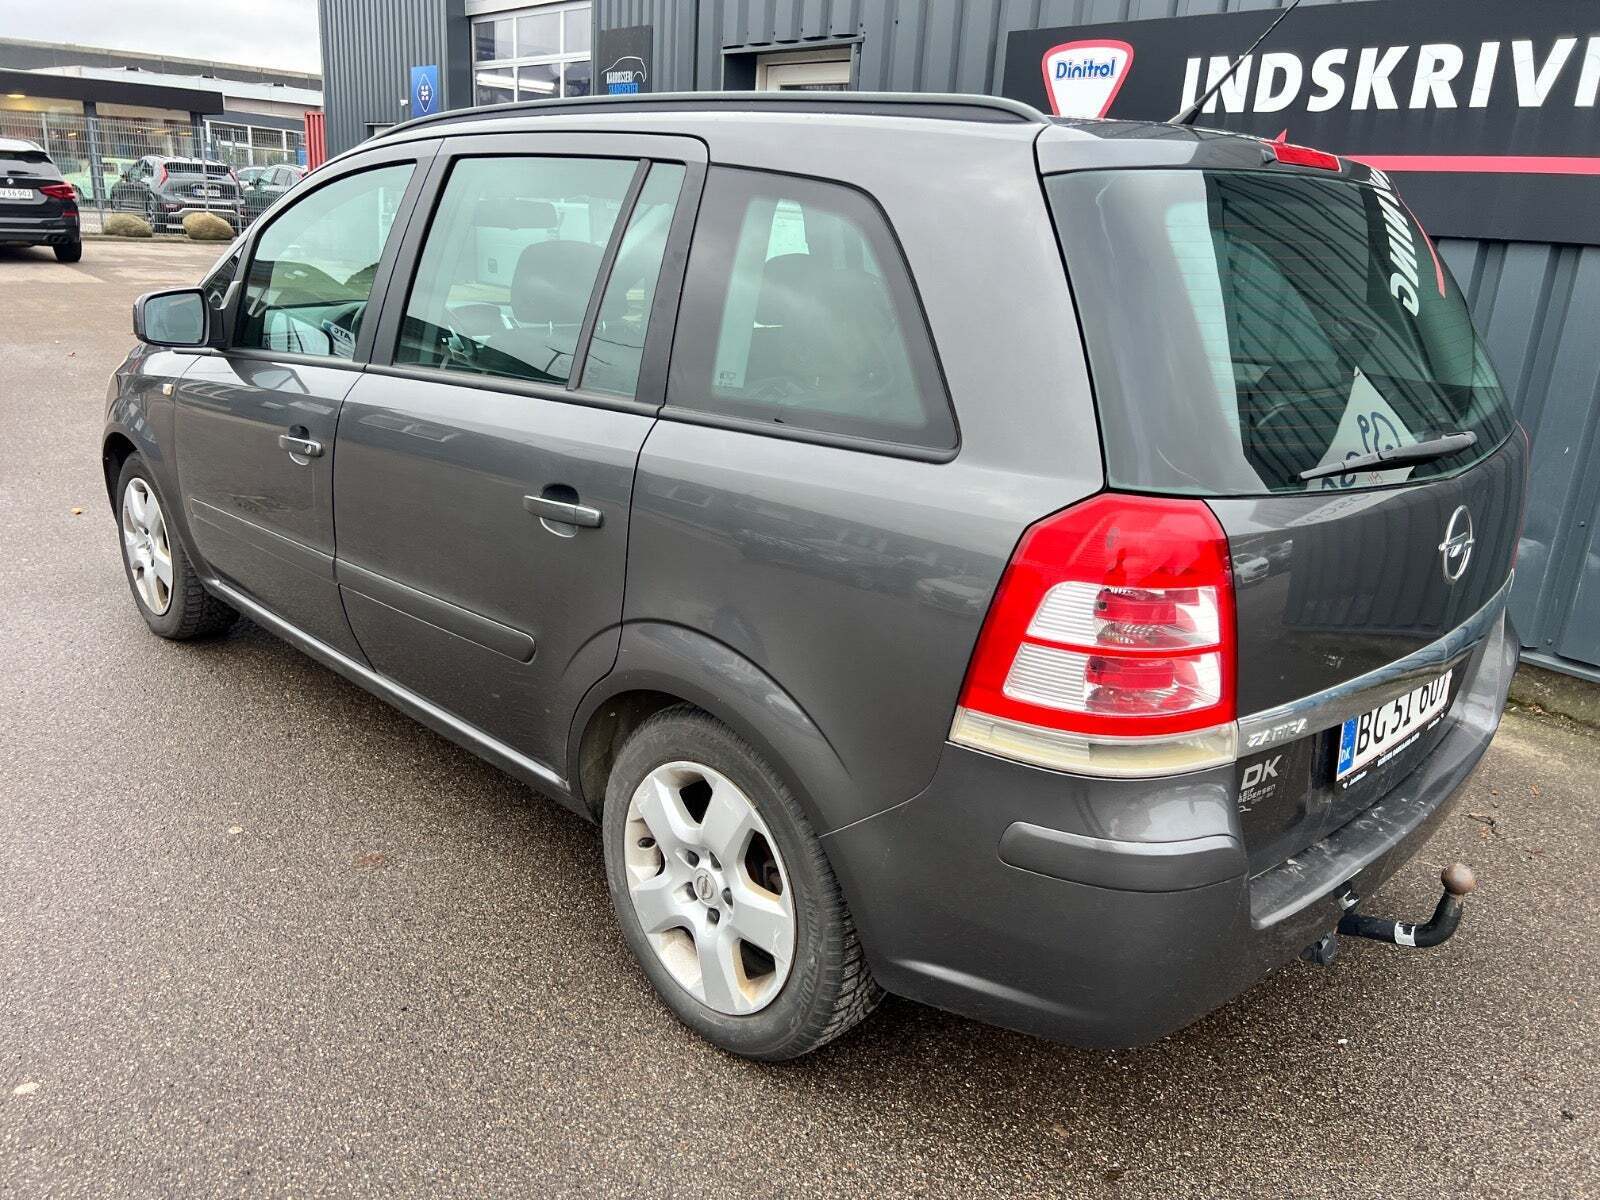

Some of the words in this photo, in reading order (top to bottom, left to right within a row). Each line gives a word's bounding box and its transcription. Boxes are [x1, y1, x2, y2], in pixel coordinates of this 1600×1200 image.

[1056, 59, 1116, 79] Dinitrol
[1356, 706, 1387, 756] BG
[1390, 692, 1412, 735] 51
[1340, 746, 1351, 763] DK
[1241, 754, 1282, 791] DK
